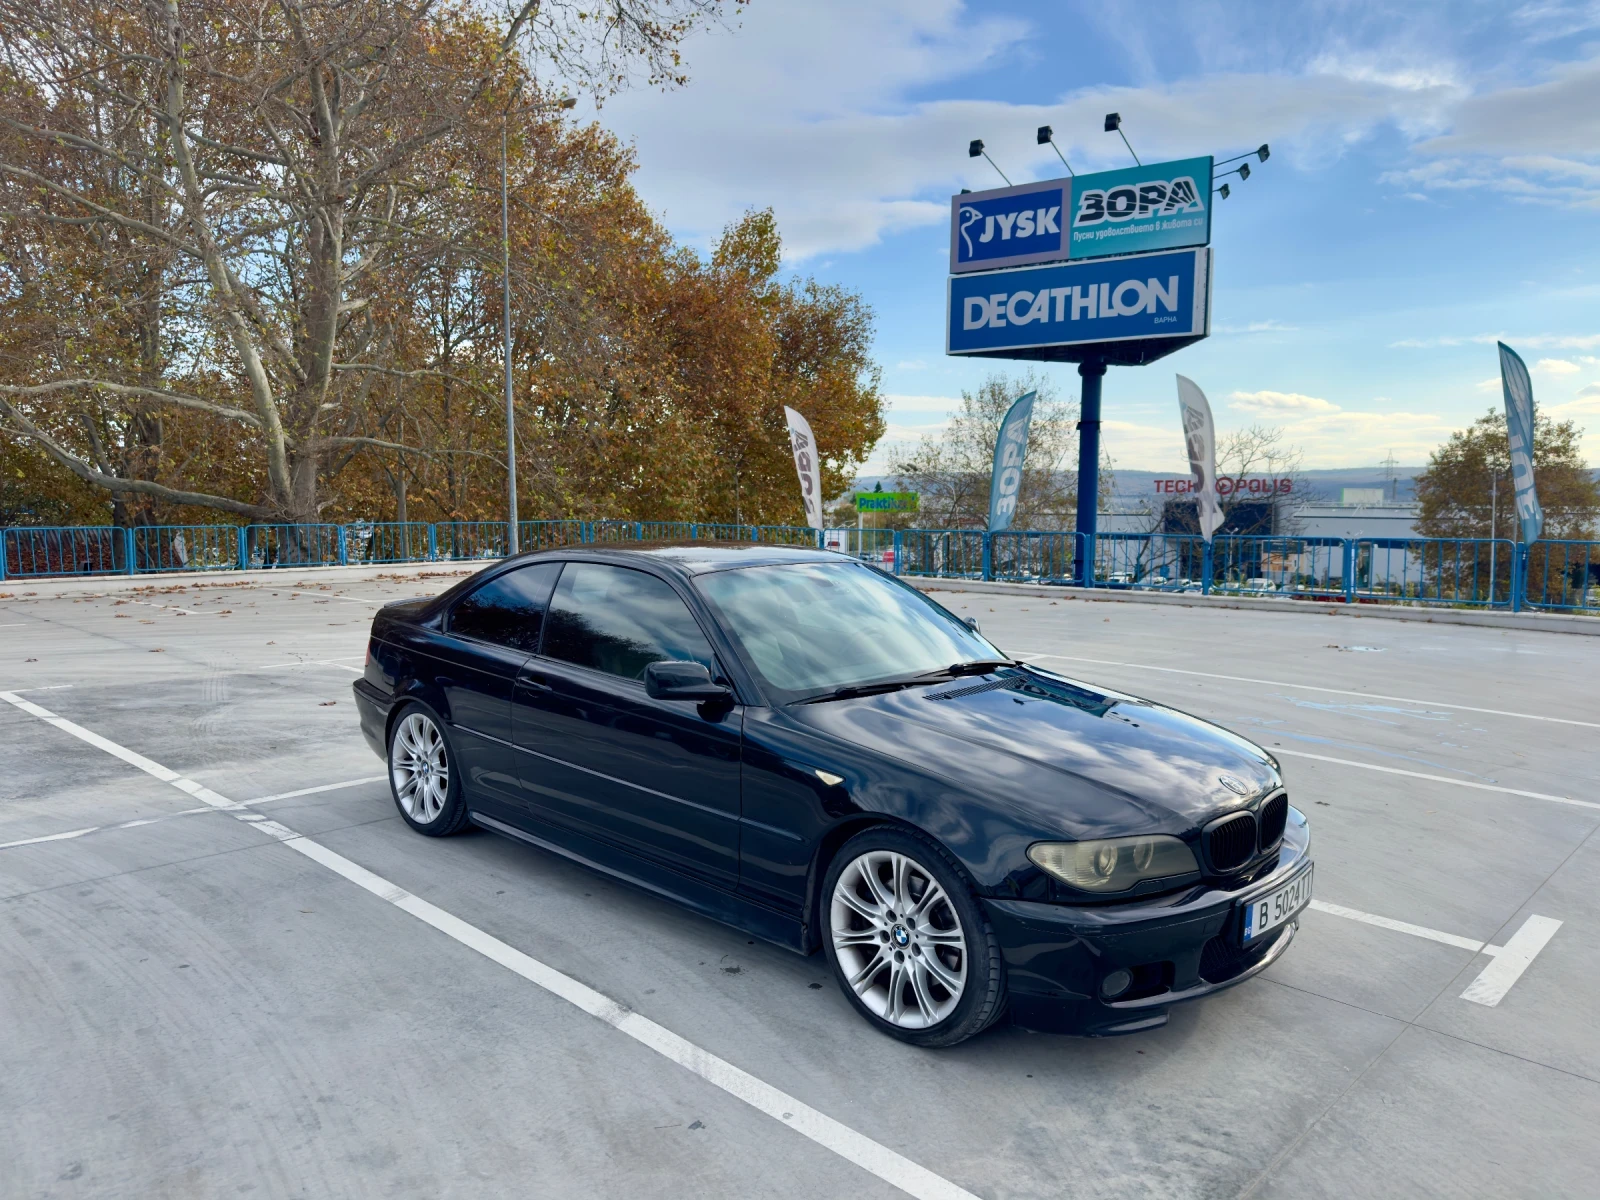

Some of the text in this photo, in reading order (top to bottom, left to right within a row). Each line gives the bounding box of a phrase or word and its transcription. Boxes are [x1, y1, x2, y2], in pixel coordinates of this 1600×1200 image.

[979, 206, 1060, 243] JYSK
[1074, 177, 1203, 226] ЗОРА
[1073, 230, 1094, 242] Пусни
[963, 276, 1179, 330] DECATHLON
[1154, 316, 1177, 324] ВАРНА
[996, 415, 1028, 516] ЗОРА
[1259, 901, 1268, 930] B
[1275, 880, 1300, 921] 5024
